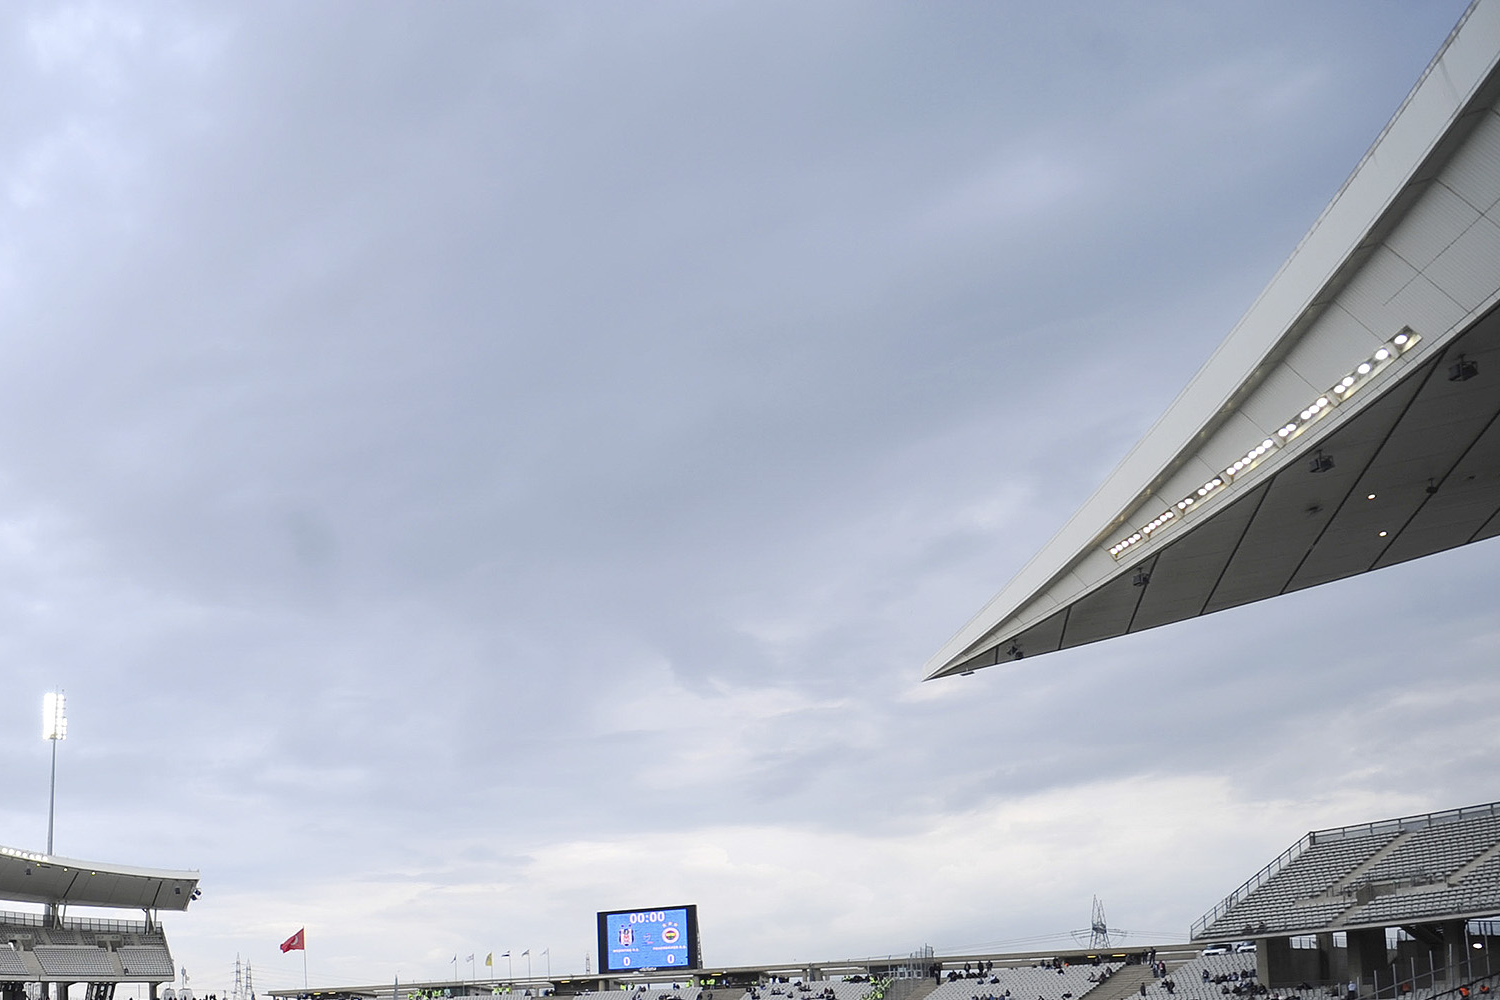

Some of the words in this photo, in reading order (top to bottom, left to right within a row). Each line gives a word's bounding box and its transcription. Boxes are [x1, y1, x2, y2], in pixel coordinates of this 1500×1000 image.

[629, 911, 665, 924] 00:00
[623, 956, 631, 966] 0
[667, 954, 675, 964] 0
